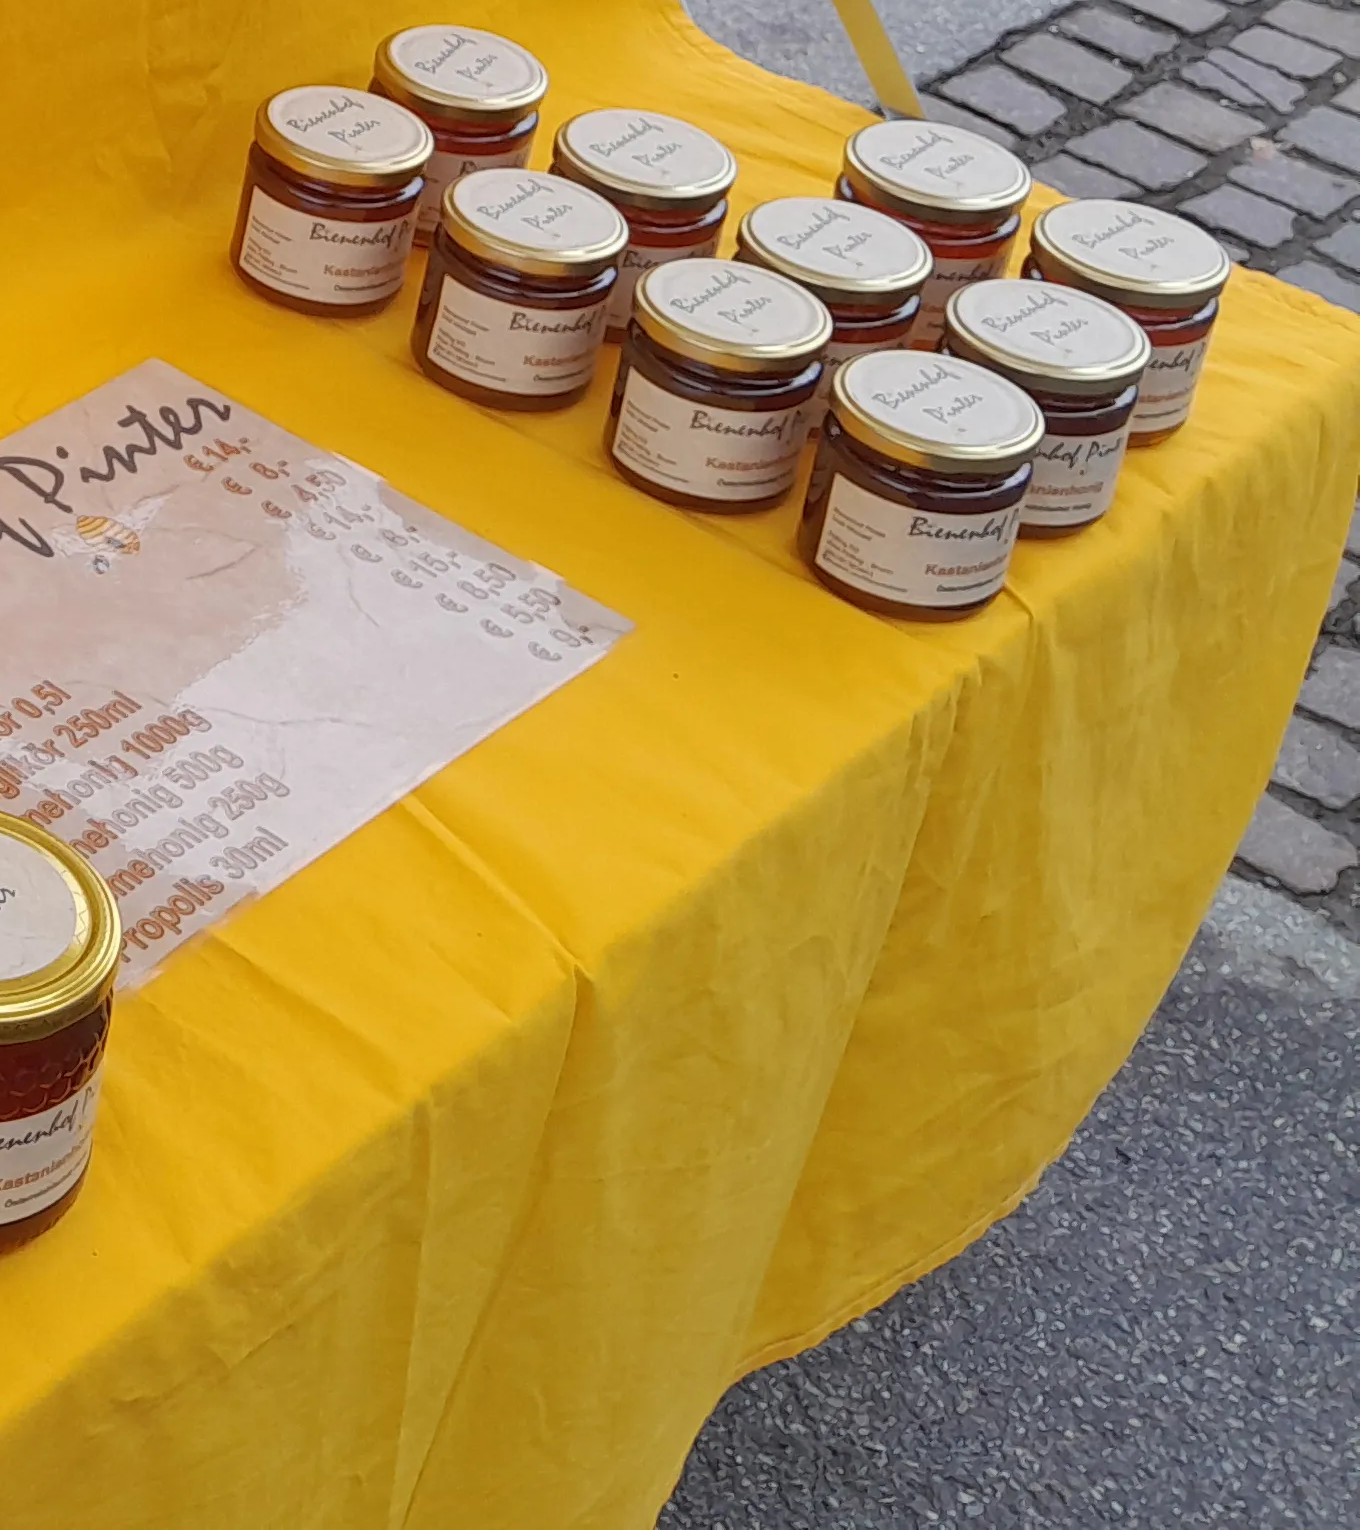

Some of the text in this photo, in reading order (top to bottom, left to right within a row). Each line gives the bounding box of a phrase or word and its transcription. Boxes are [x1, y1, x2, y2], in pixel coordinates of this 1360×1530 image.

[309, 221, 396, 252] Bienenhof
[509, 311, 596, 334] Bienenhof
[690, 410, 788, 439] Bienenhof
[183, 454, 215, 471] €
[221, 476, 253, 495] €
[261, 500, 292, 519] €
[908, 513, 1007, 542] Bienenhof
[11, 679, 72, 719] 0,5l
[53, 690, 142, 749] 250ml
[121, 708, 212, 759] 1000g
[164, 745, 244, 790] 500g
[208, 772, 290, 820] 250g
[209, 826, 288, 879] 30ml
